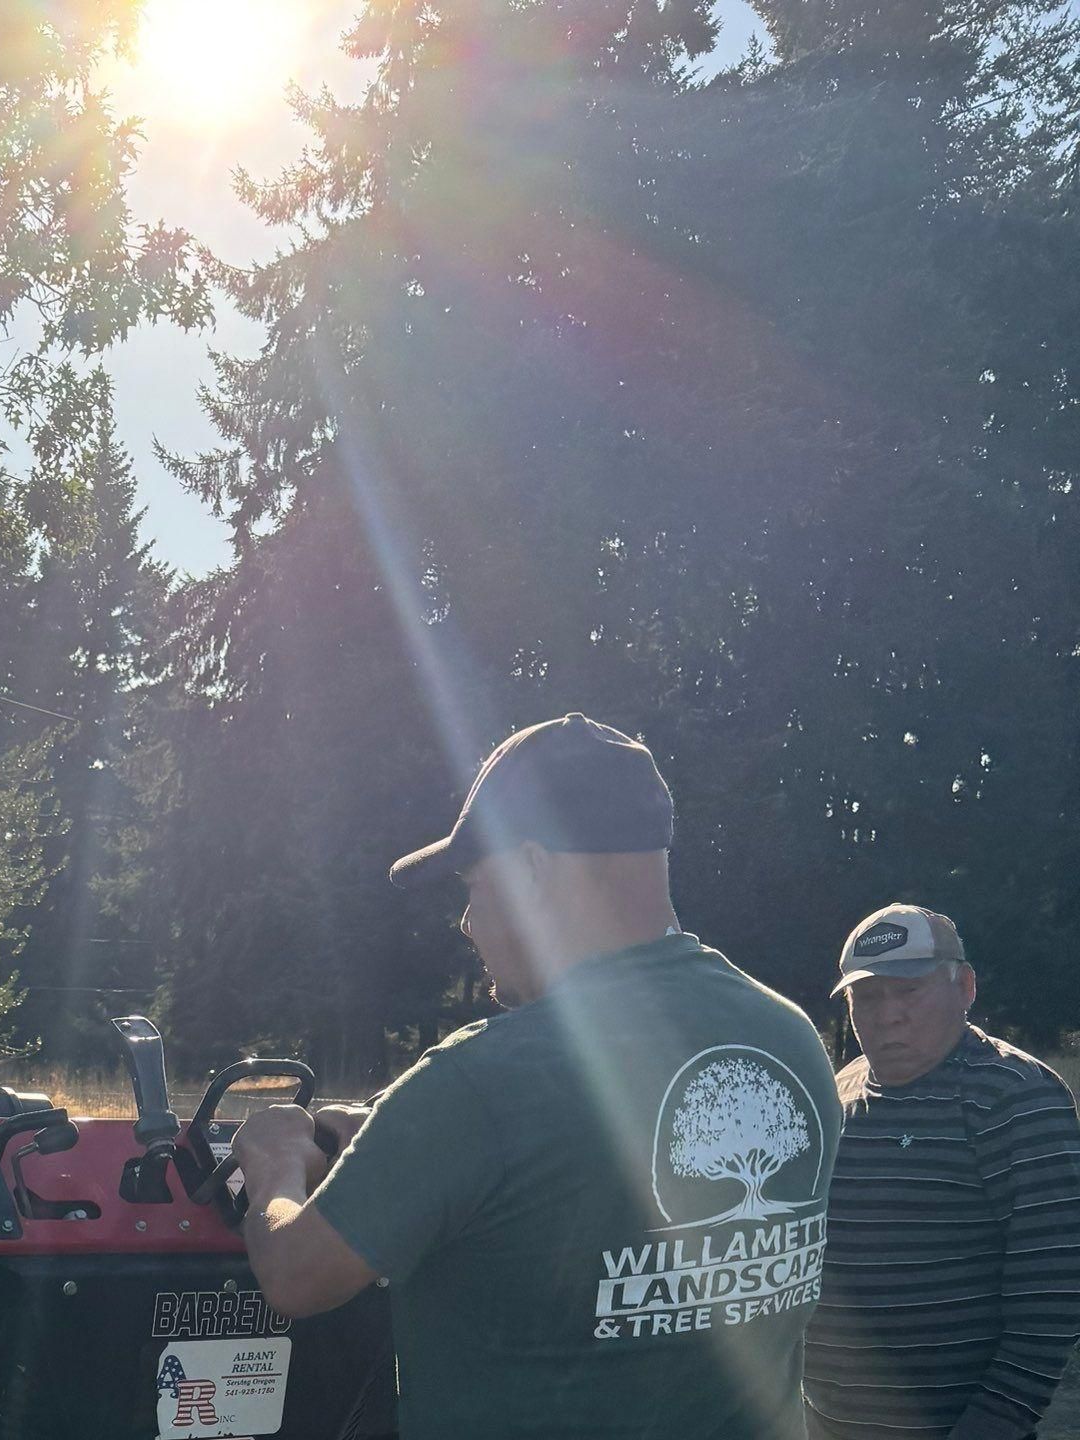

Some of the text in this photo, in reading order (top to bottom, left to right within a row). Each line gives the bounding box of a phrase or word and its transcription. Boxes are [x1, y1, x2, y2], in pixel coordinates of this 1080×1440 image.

[859, 931, 903, 946] Wrangler
[602, 1210, 827, 1278] WILLAMETT
[593, 1278, 821, 1339] & TREE SERVICES
[233, 1351, 277, 1362] ALBANY
[231, 1362, 274, 1373] RENTAL
[226, 1377, 276, 1387] Serving Oregon
